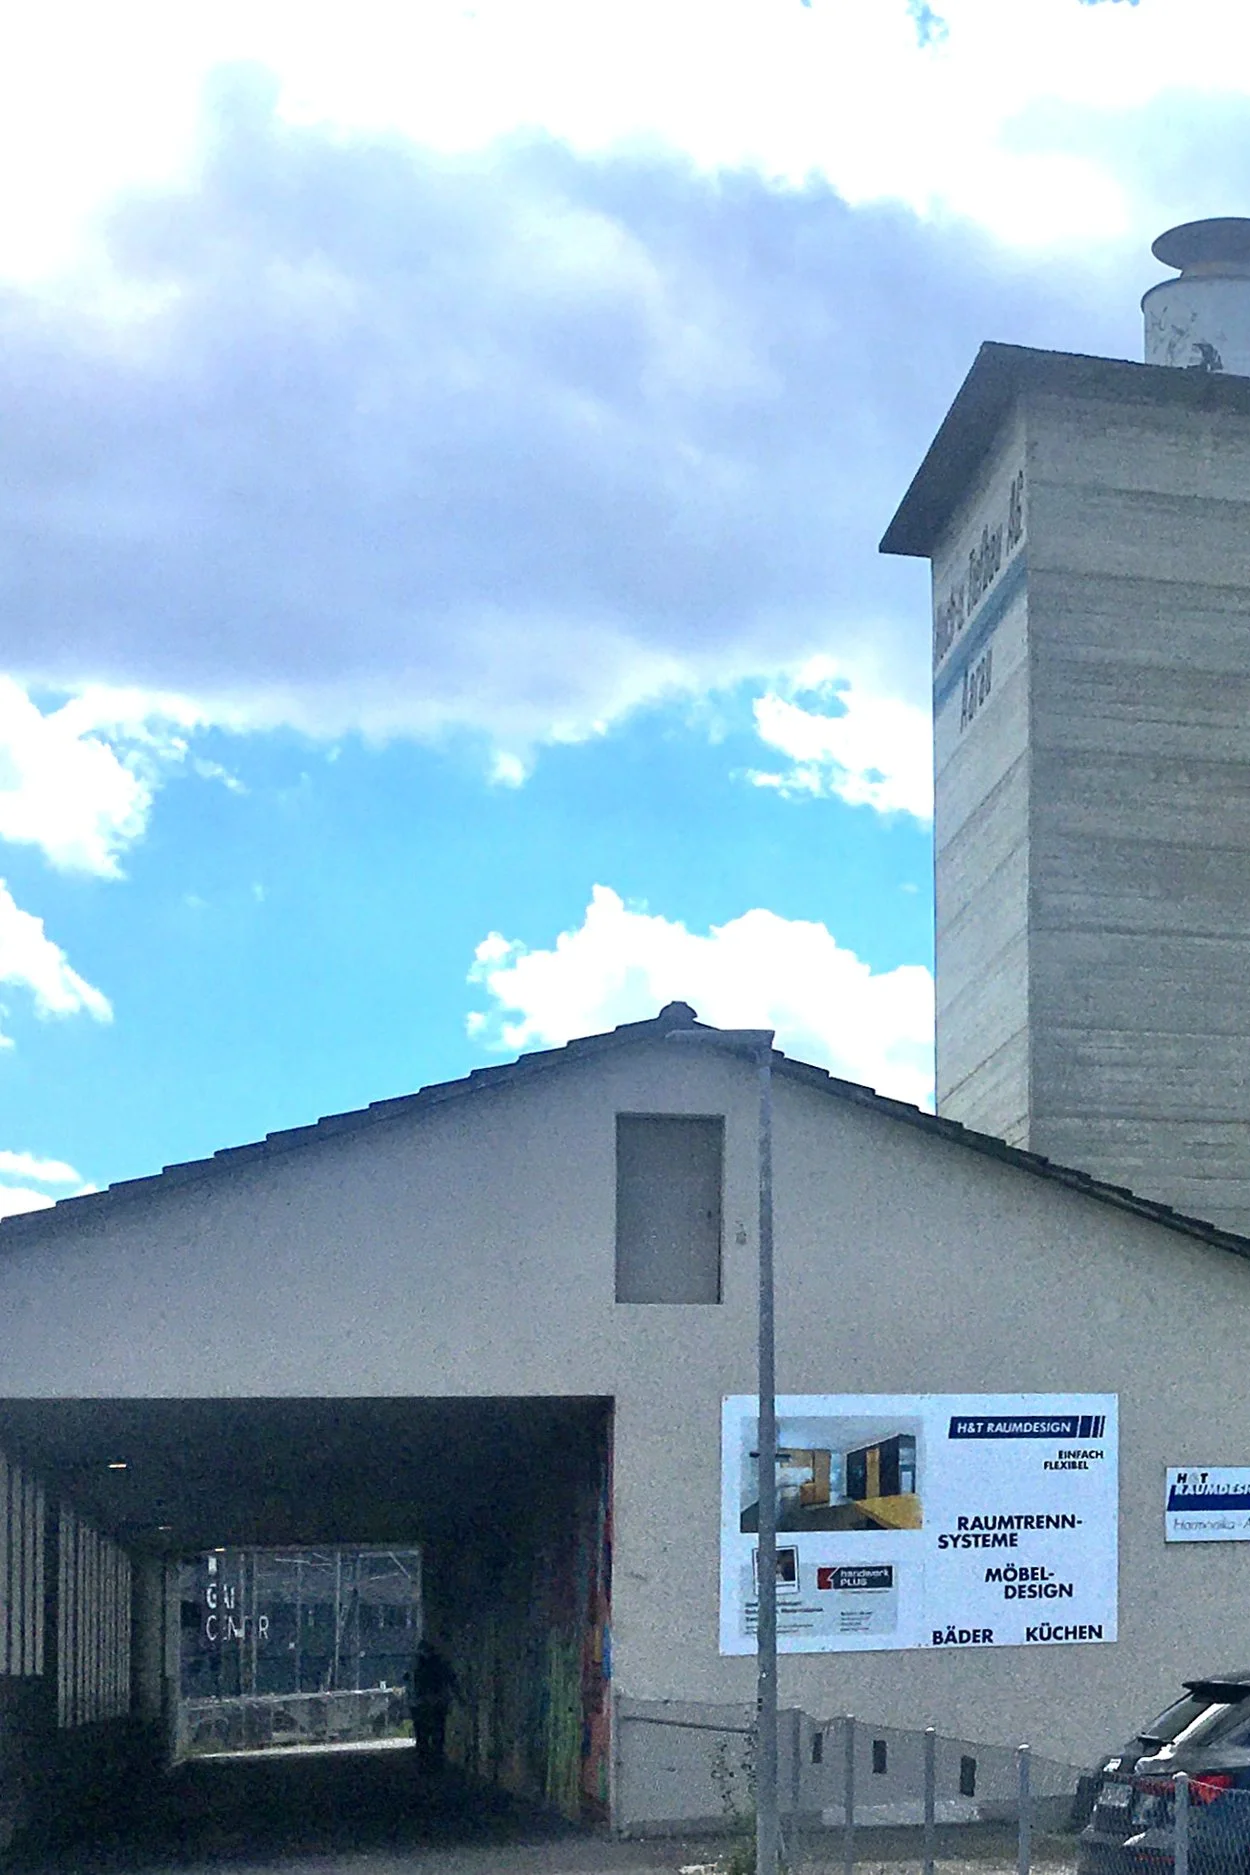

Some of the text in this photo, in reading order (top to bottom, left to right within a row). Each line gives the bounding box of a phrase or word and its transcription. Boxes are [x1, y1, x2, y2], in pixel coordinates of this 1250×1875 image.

[956, 1421, 1072, 1434] H&T RAUMDESIGN
[1057, 1449, 1104, 1460] EINFACH
[1043, 1460, 1089, 1470] FLEXIBEL
[957, 1513, 1083, 1531] RAUMTRENN-
[937, 1532, 1019, 1550] SYSTEME
[984, 1562, 1055, 1583] MÖBEL-
[840, 1577, 868, 1587] PLUS
[1003, 1583, 1074, 1600] DESIGN
[931, 1622, 1104, 1646] BÄDER KÜCHEN
